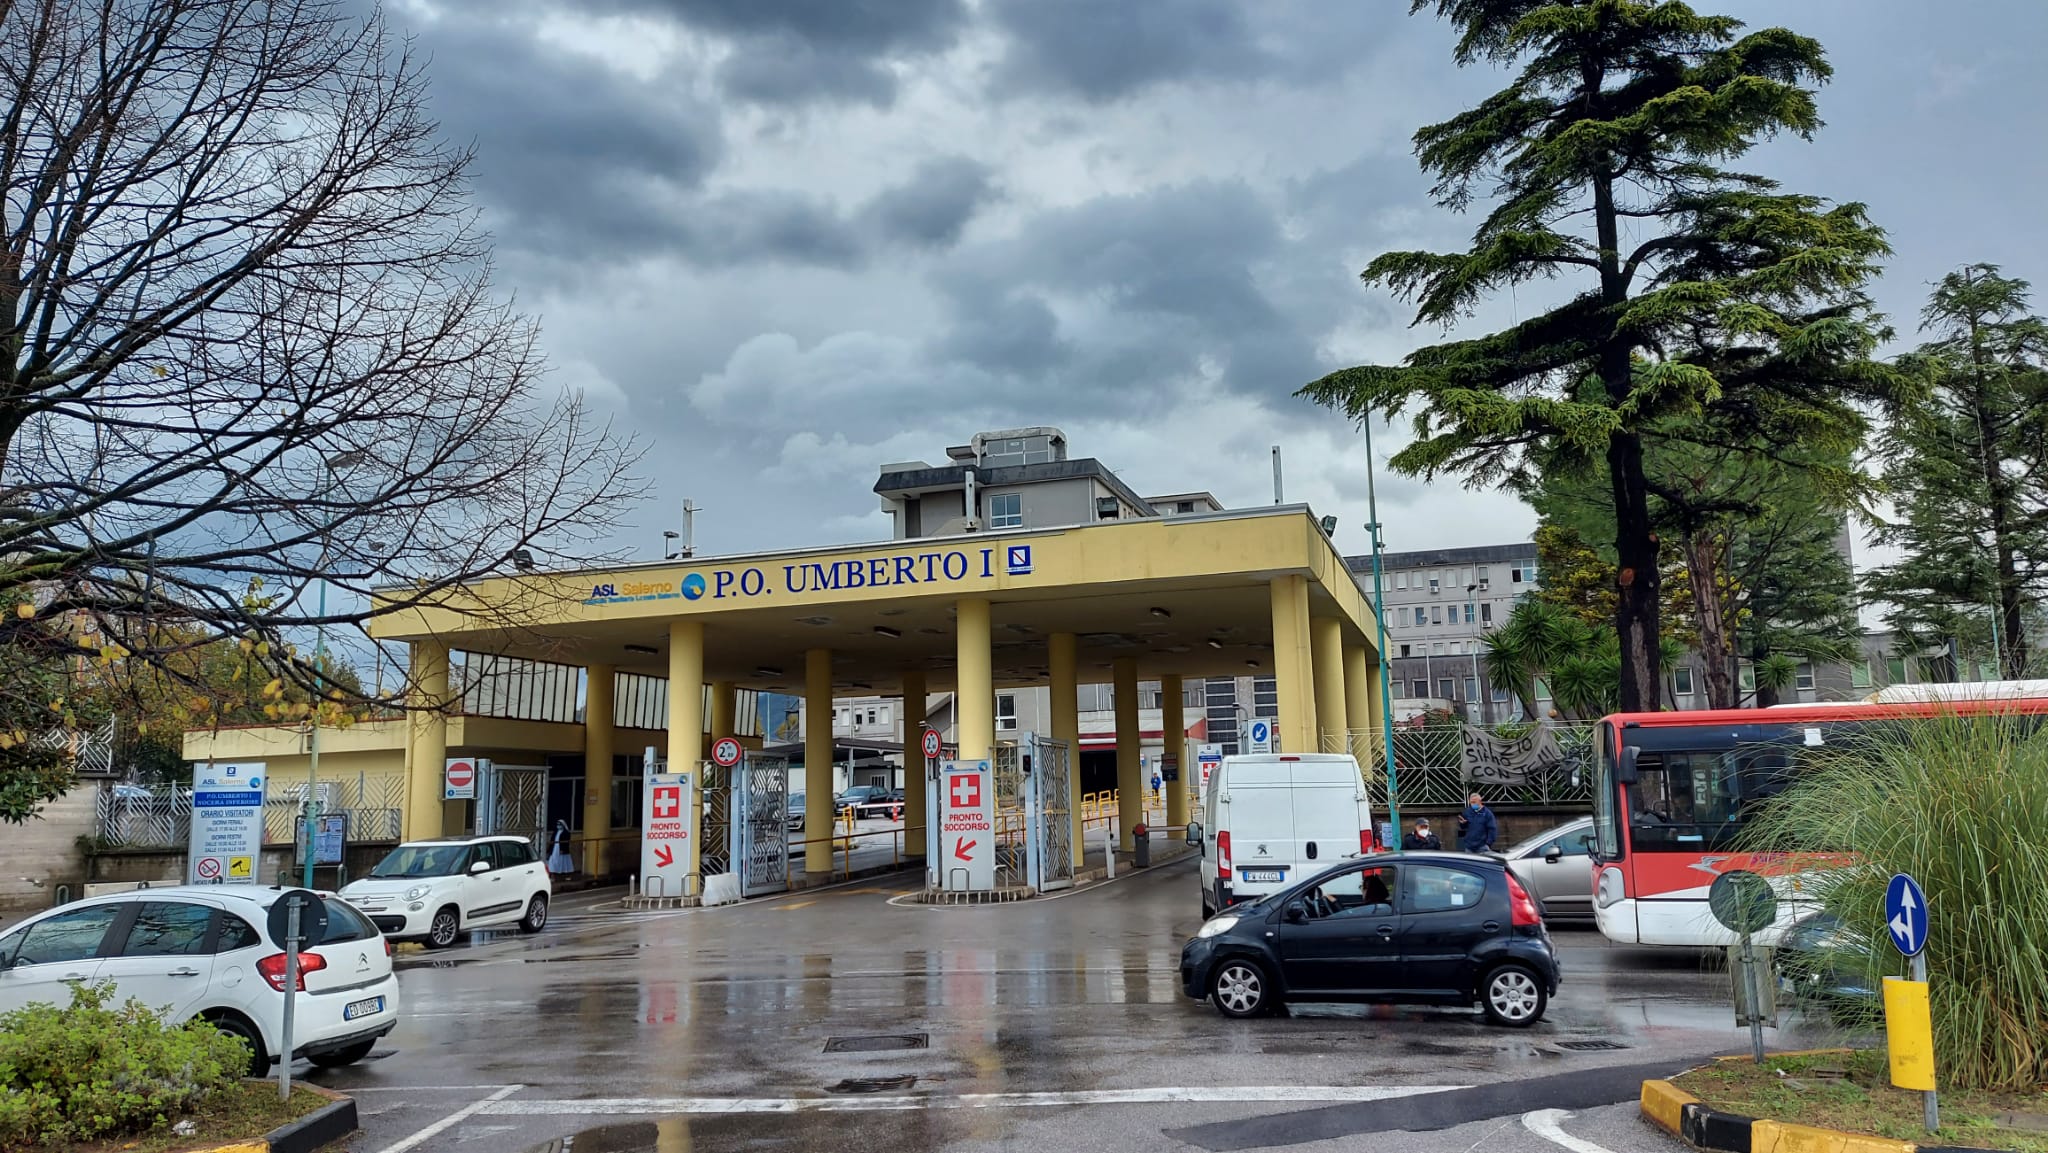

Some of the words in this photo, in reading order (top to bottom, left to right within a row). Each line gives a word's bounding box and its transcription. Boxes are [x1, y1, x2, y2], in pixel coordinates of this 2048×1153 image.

[713, 568, 772, 598] P.O.
[783, 551, 968, 593] UMBERTO
[979, 549, 994, 577] I
[592, 584, 618, 598] ASL
[622, 581, 673, 595] Salerno
[1500, 737, 1532, 756] ZIO
[1471, 765, 1510, 779] CON
[201, 810, 224, 818] ORARIO
[225, 809, 254, 817] VISITATORI
[949, 813, 983, 821] PRONTO
[651, 822, 681, 830] PRONTO
[944, 822, 990, 831] SOCCORSO
[646, 831, 687, 840] SOCCORSO
